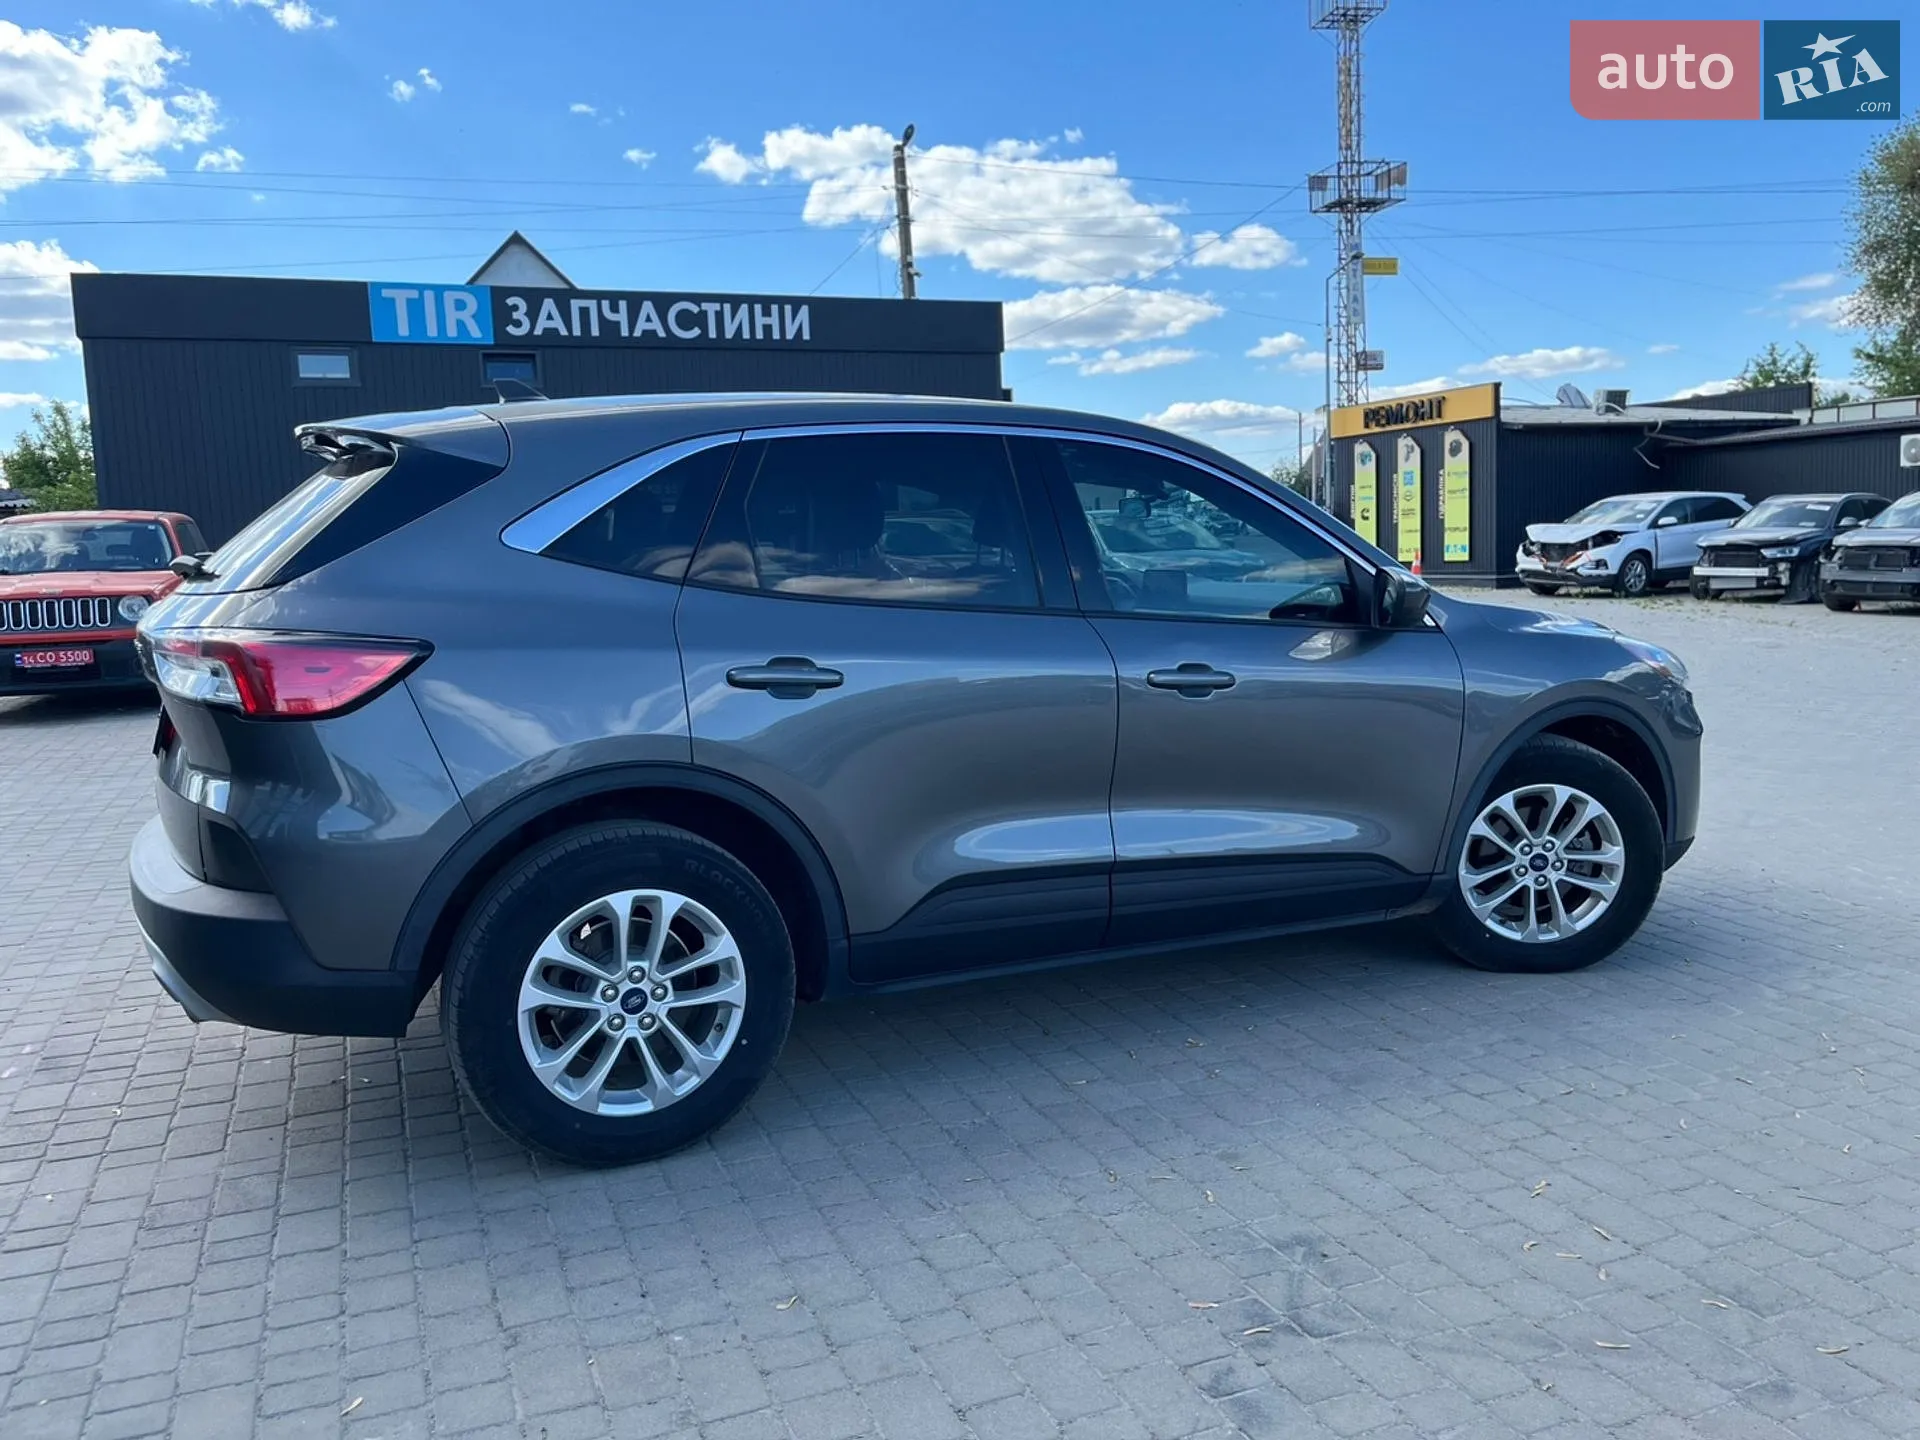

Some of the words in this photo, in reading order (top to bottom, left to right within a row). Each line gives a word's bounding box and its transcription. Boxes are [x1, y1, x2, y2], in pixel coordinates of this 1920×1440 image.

[381, 289, 483, 339] TIR
[505, 297, 811, 341] ЗАПЧАСТИНИ
[1363, 396, 1446, 429] РЕМОНТ
[59, 650, 90, 662] 5500
